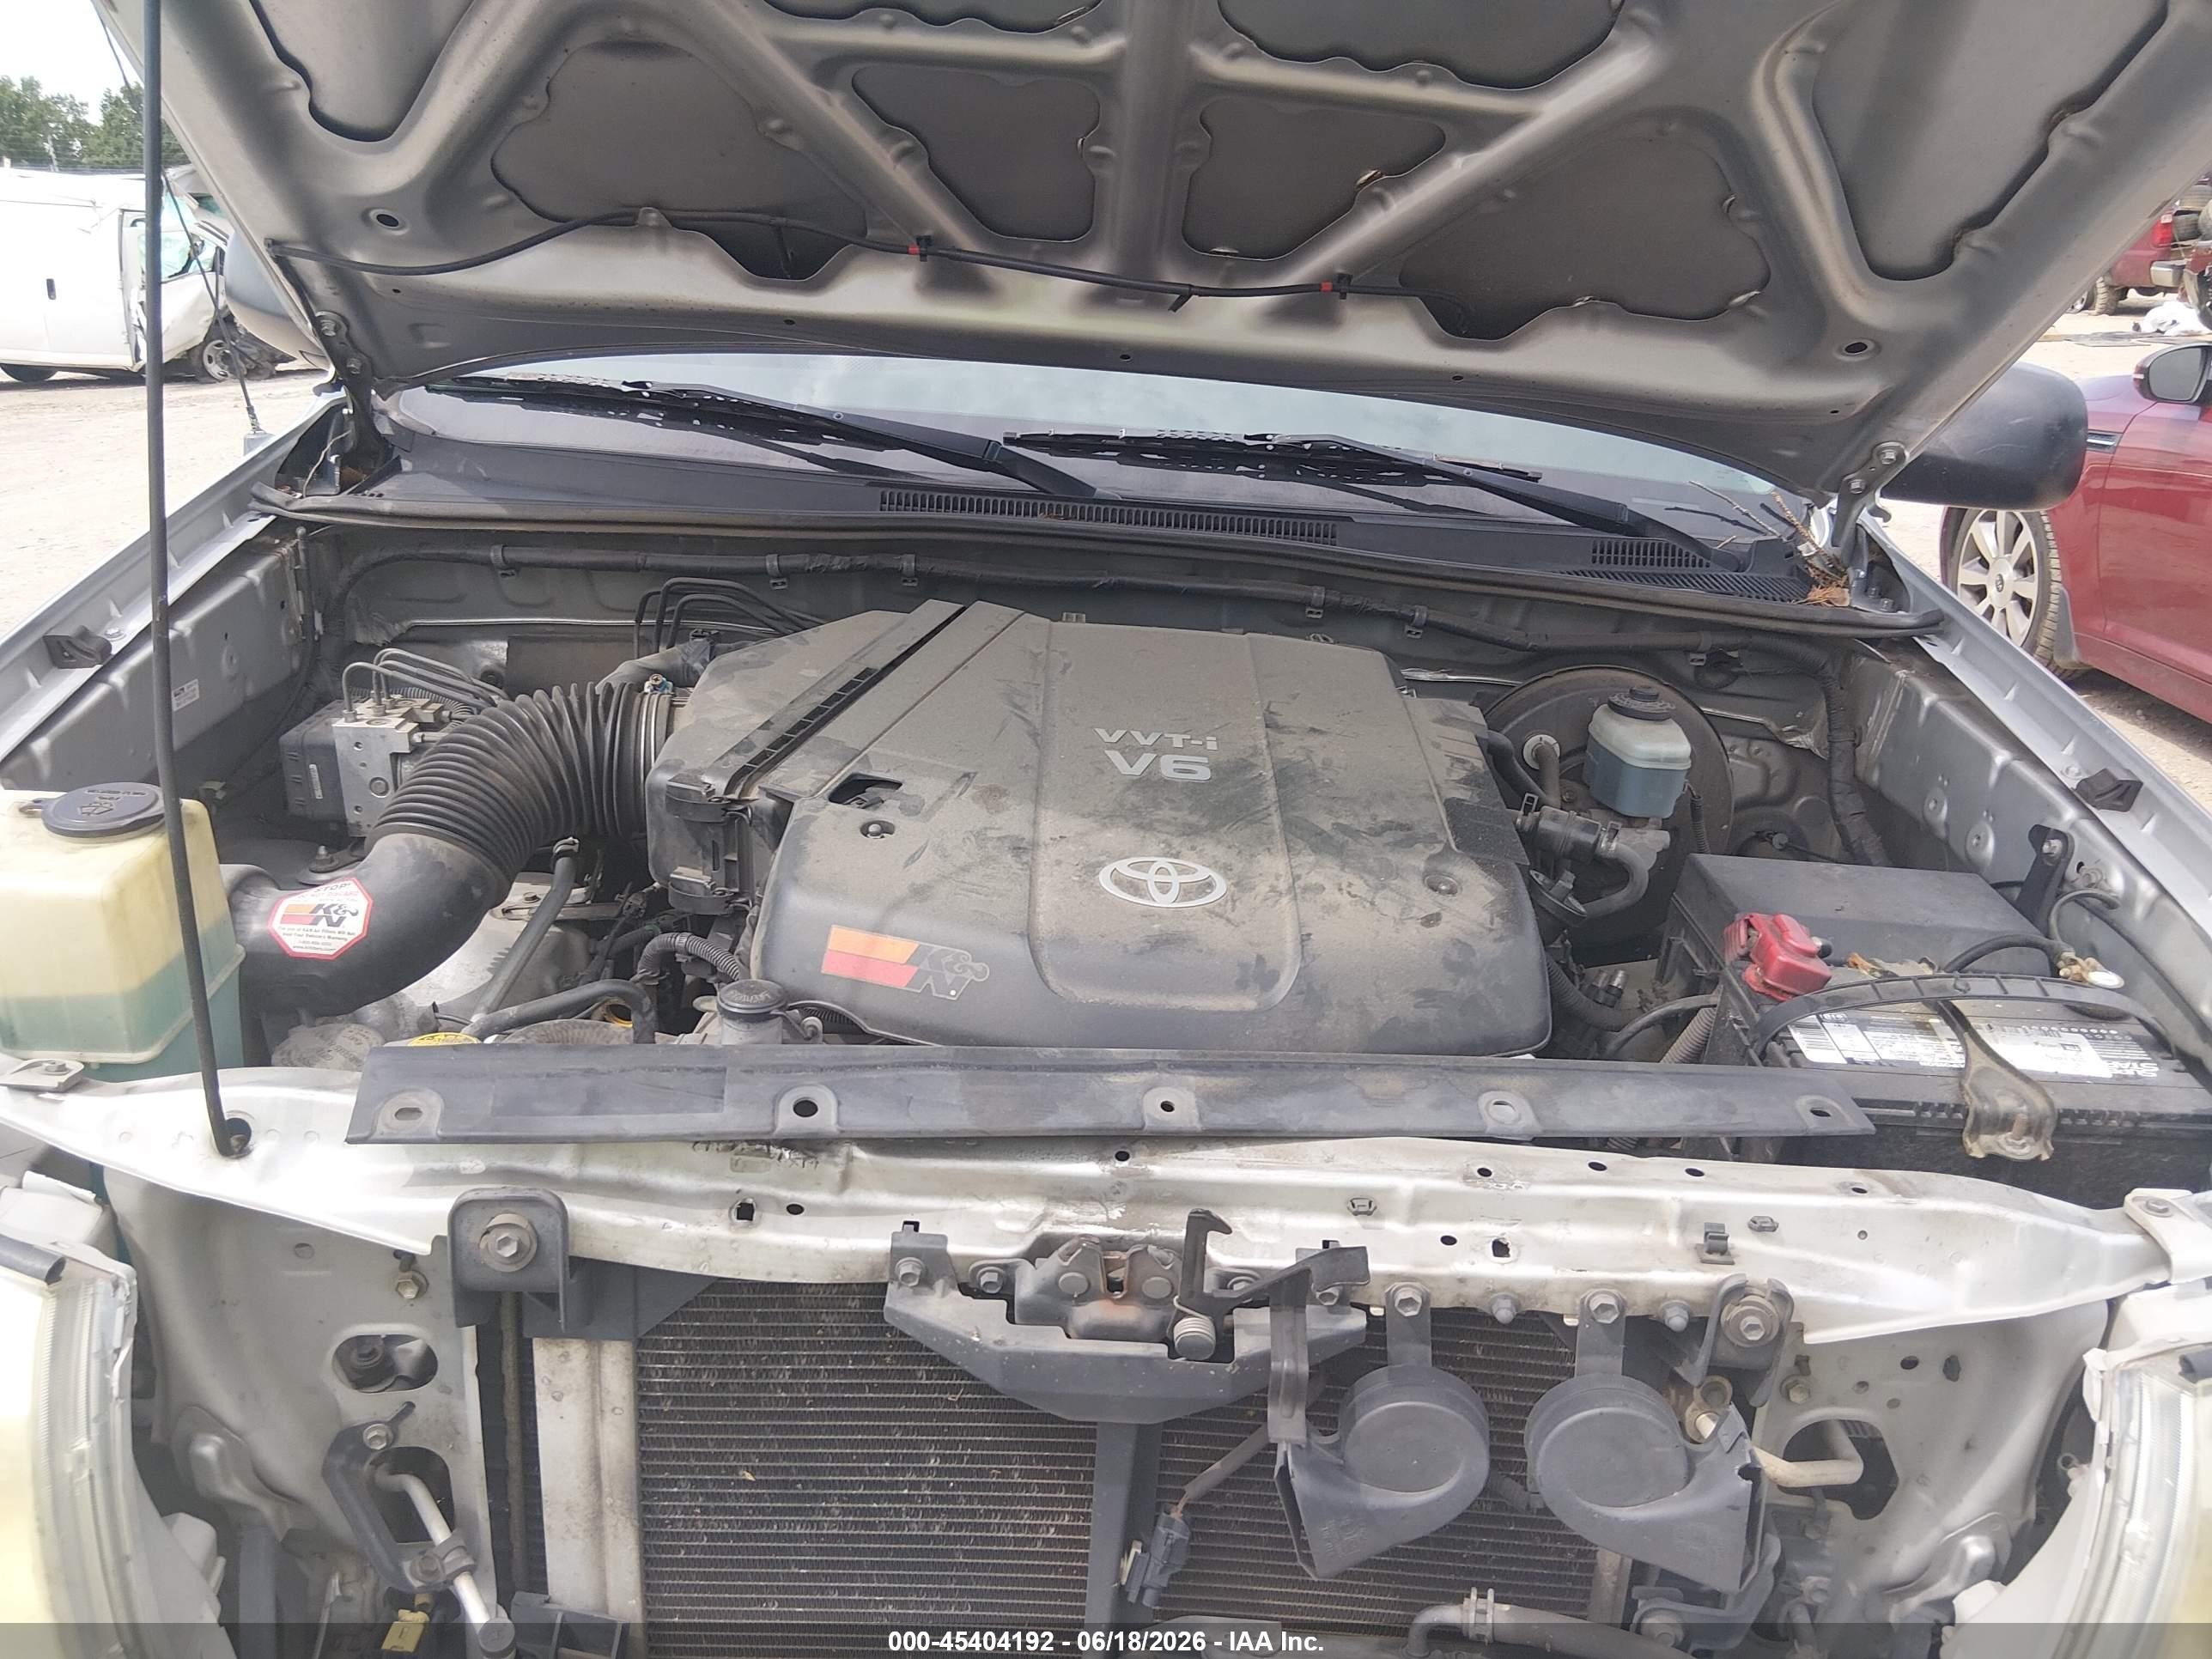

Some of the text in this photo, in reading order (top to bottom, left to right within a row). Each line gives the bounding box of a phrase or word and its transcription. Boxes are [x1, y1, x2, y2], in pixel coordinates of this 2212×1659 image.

[1092, 727, 1218, 750] VVT-i
[1103, 750, 1212, 781] V6
[309, 903, 359, 927] K&N
